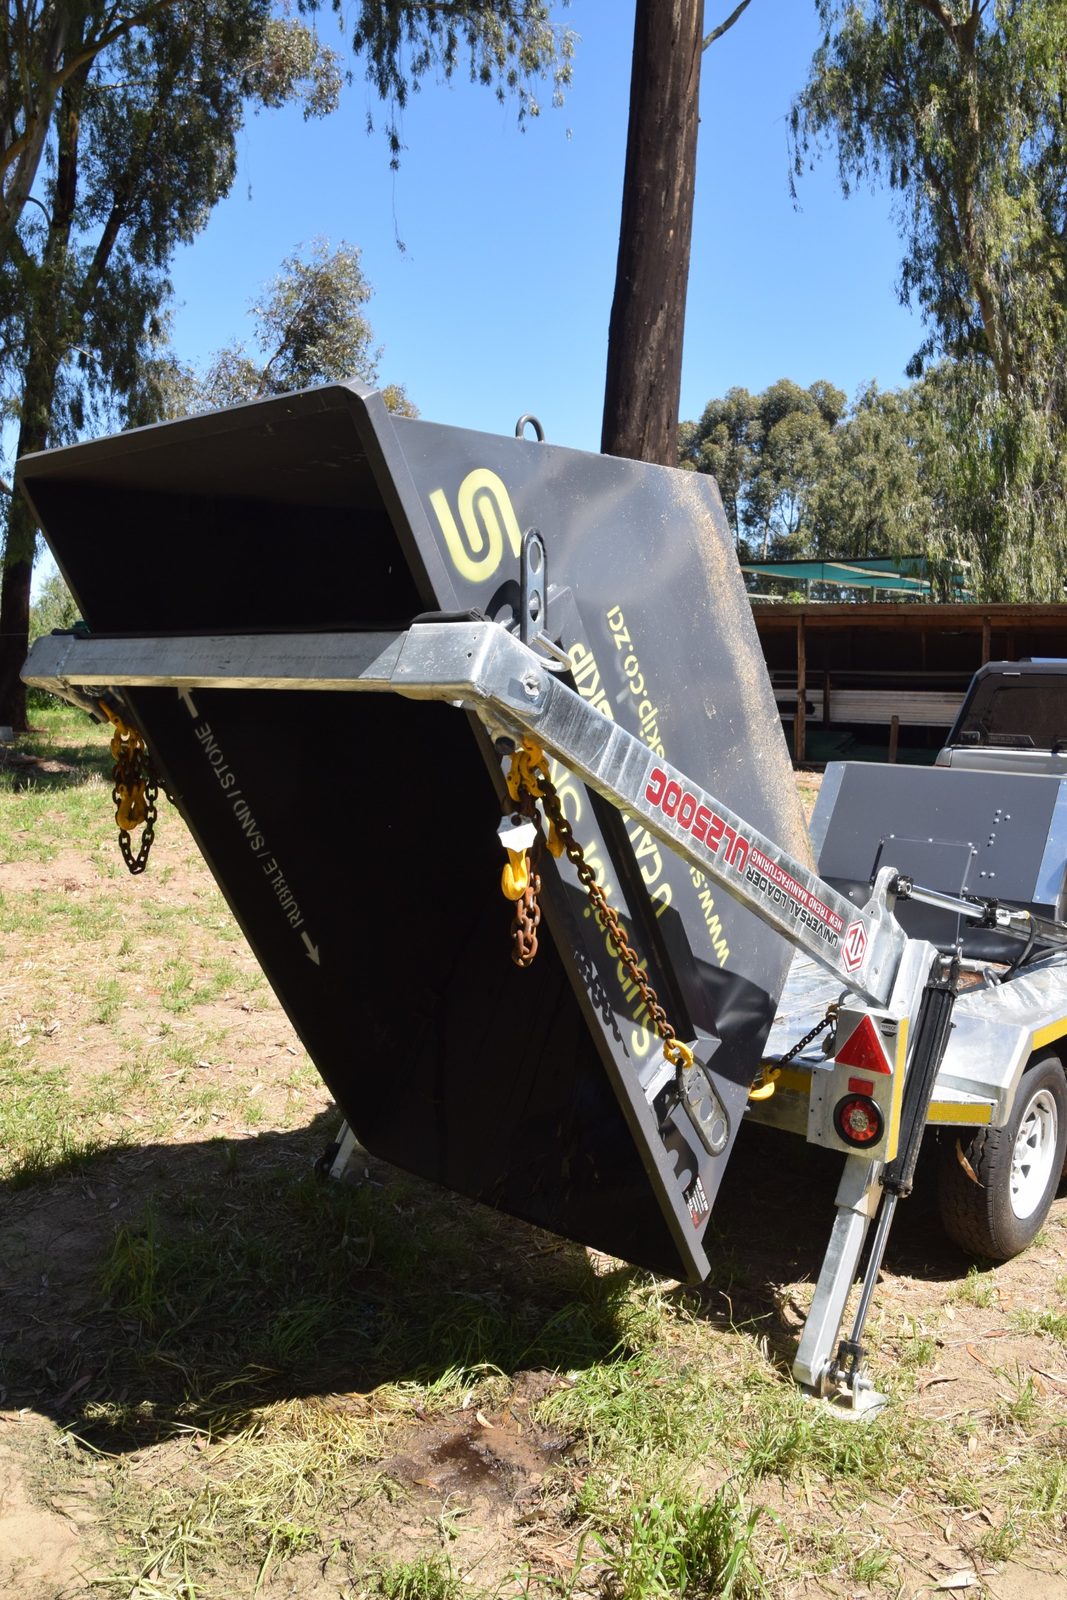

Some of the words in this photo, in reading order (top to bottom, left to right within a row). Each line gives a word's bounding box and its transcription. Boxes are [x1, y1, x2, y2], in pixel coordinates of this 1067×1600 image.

[194, 722, 236, 789] STONE
[233, 799, 265, 851] SAND
[645, 767, 750, 873] UL2500C
[262, 857, 305, 928] RUBBLE
[745, 865, 788, 907] LOADER
[751, 850, 809, 903] MANUFACTURING
[788, 900, 839, 947] UNIVERSAL
[807, 897, 829, 918] TREND
[828, 914, 843, 931] NEW
